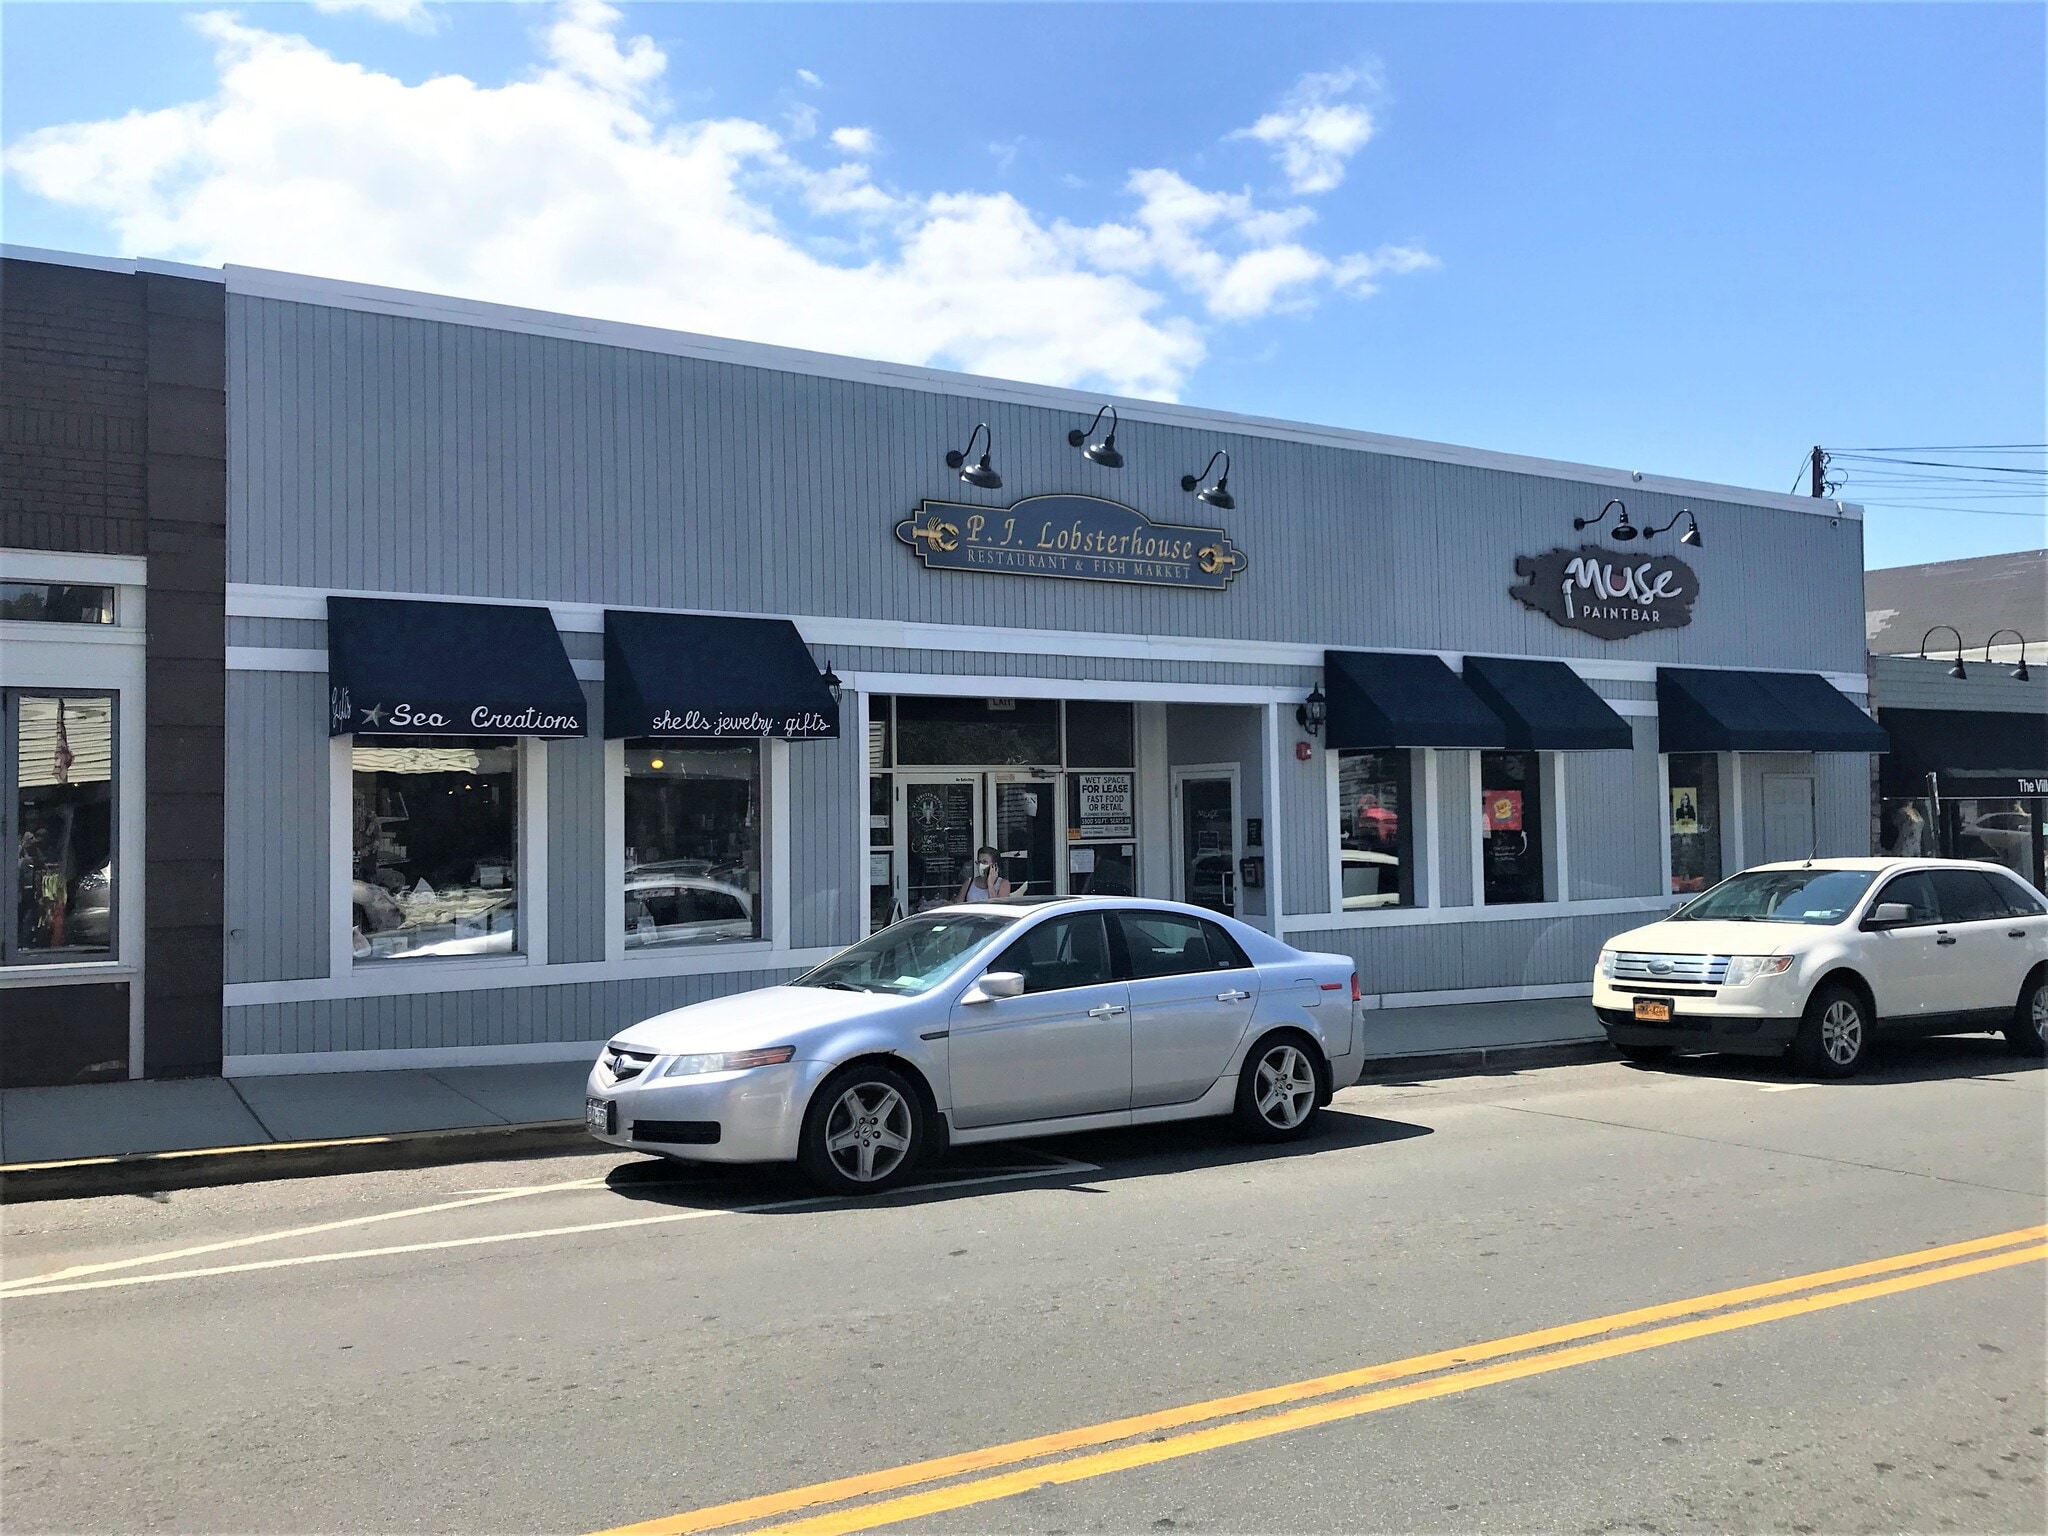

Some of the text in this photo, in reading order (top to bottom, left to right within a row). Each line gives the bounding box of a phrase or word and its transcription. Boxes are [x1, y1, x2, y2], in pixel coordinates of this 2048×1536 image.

[1037, 520, 1193, 559] Lobsterhouse
[967, 549, 1191, 579] RESTAURANT & FISH MARKET
[1583, 605, 1660, 622] PAINTBAR
[389, 703, 580, 729] Sea Creations
[652, 710, 831, 737] shells jewelry gifts
[1084, 776, 1126, 784] WET SPACE
[2017, 778, 2034, 793] The
[1081, 784, 1129, 793] FOR LEASE
[1087, 795, 1125, 803] FAST FOOD
[1088, 803, 1123, 811] OR RETAIL
